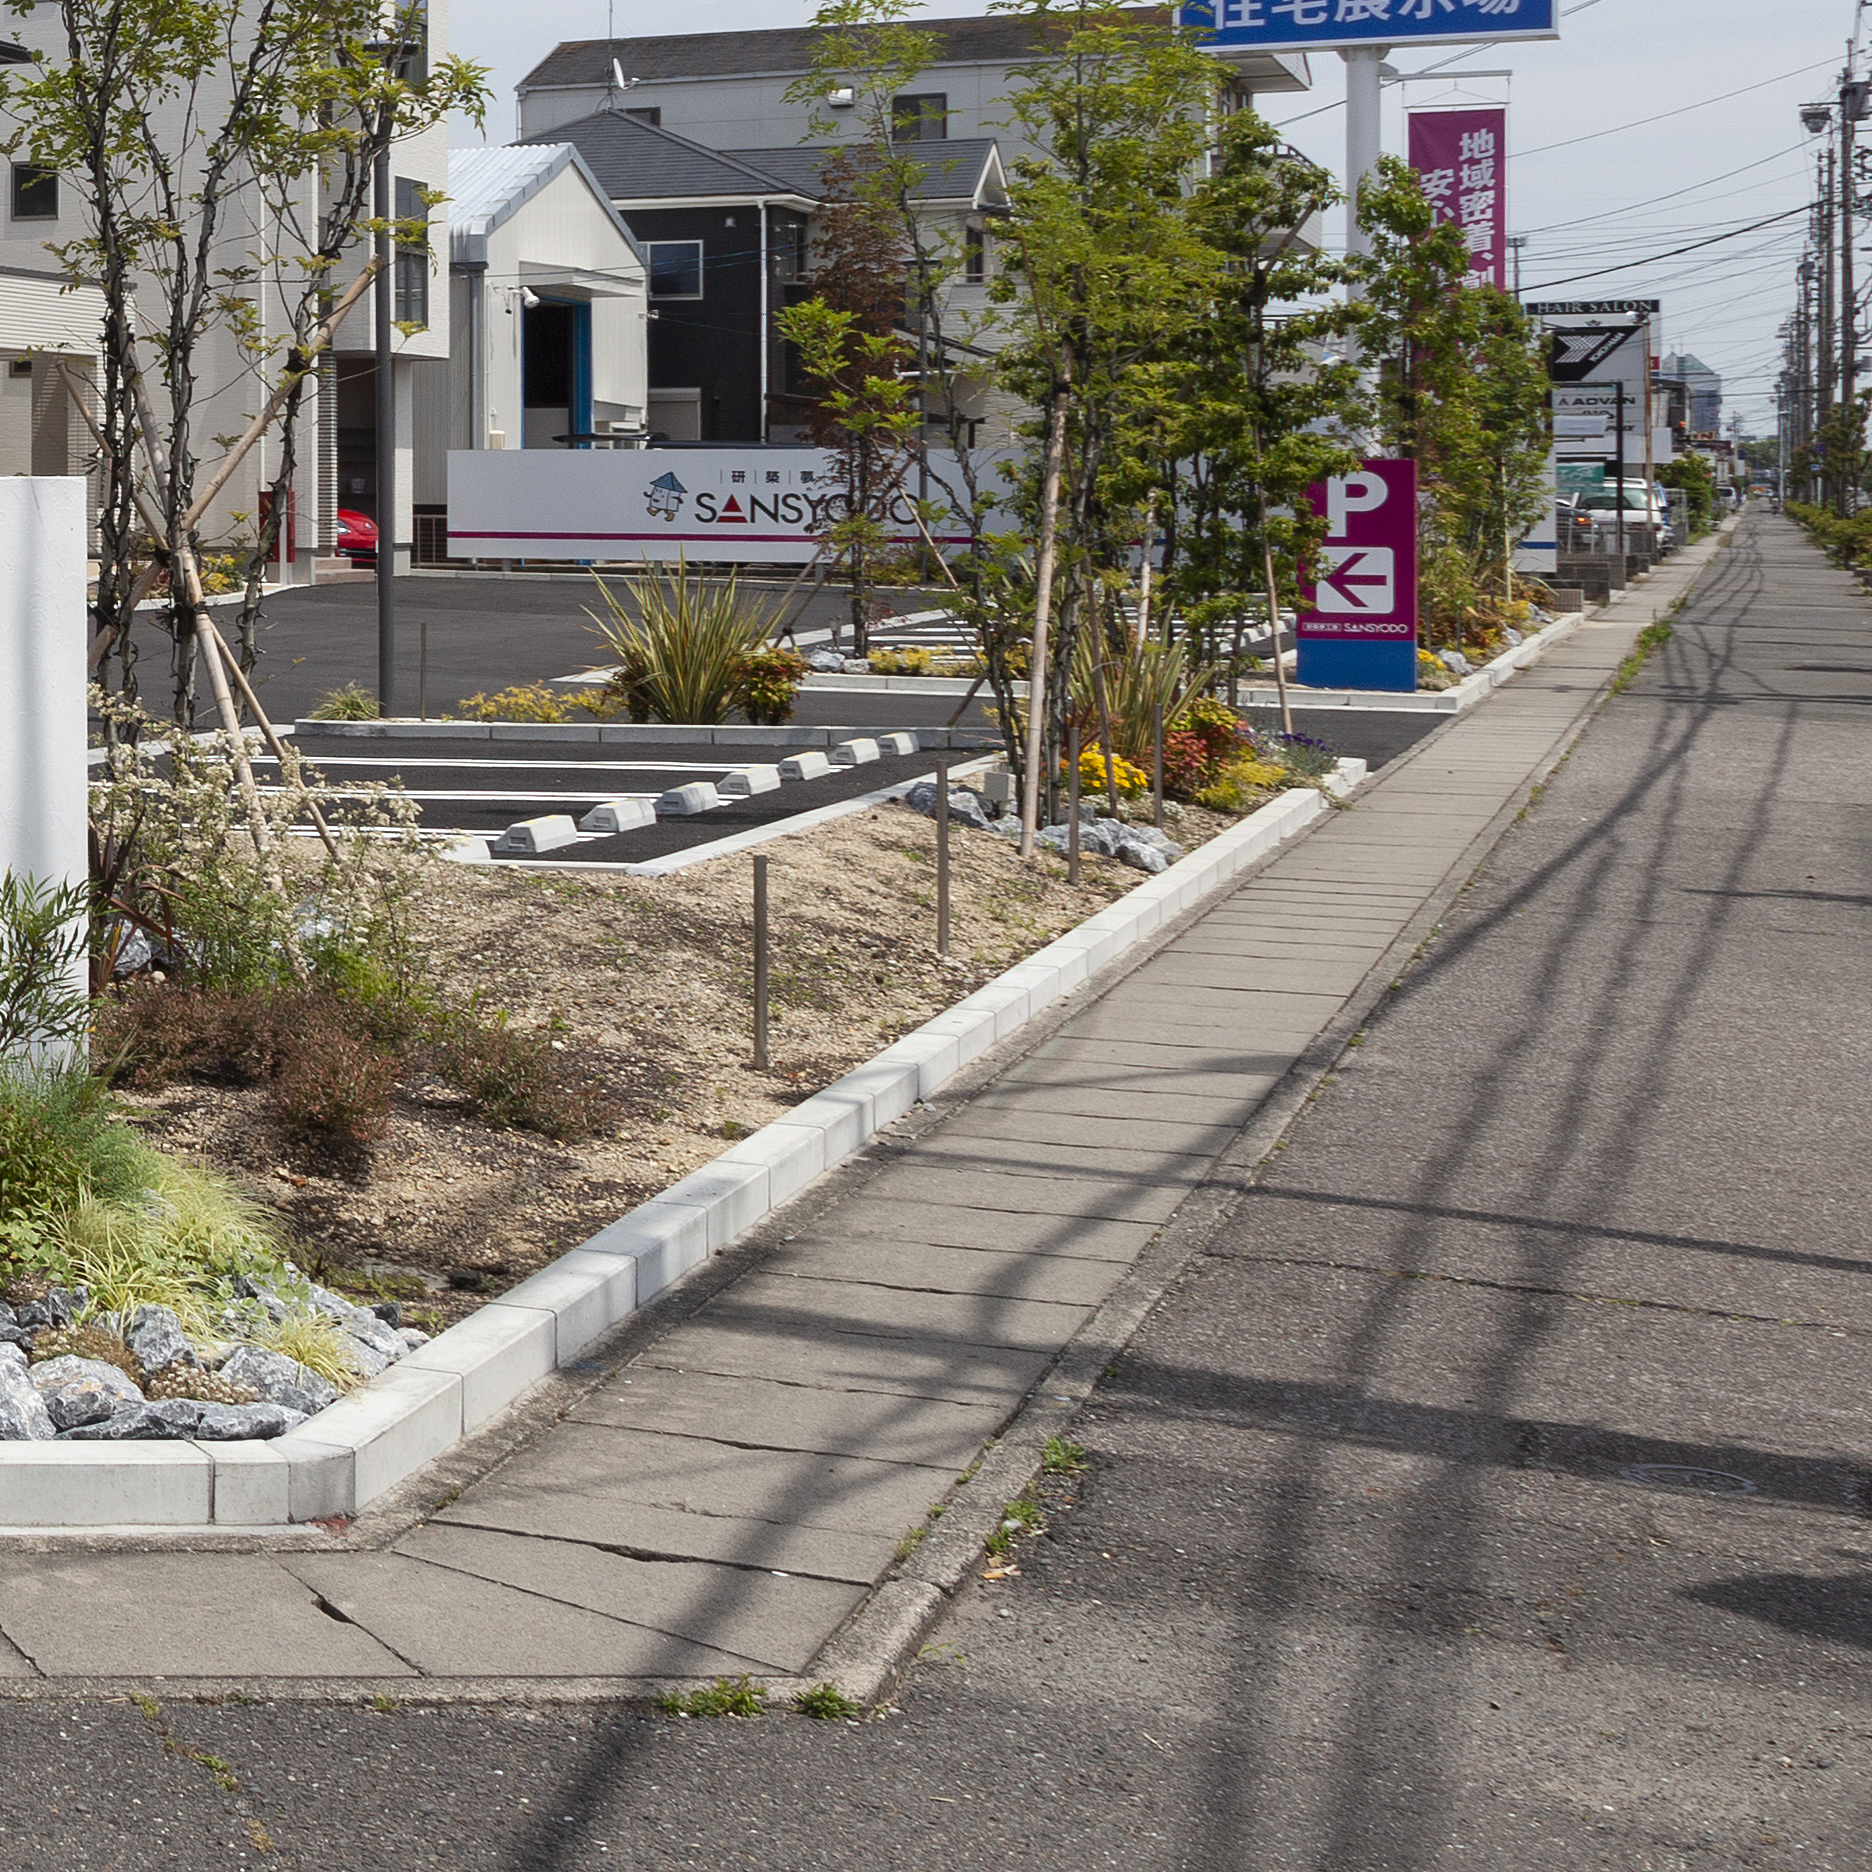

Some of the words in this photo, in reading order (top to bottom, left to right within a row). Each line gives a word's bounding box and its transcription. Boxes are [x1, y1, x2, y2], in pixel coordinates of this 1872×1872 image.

[1537, 301, 1584, 314] HAIR
[1589, 299, 1652, 313] SALON
[1327, 470, 1389, 538] P
